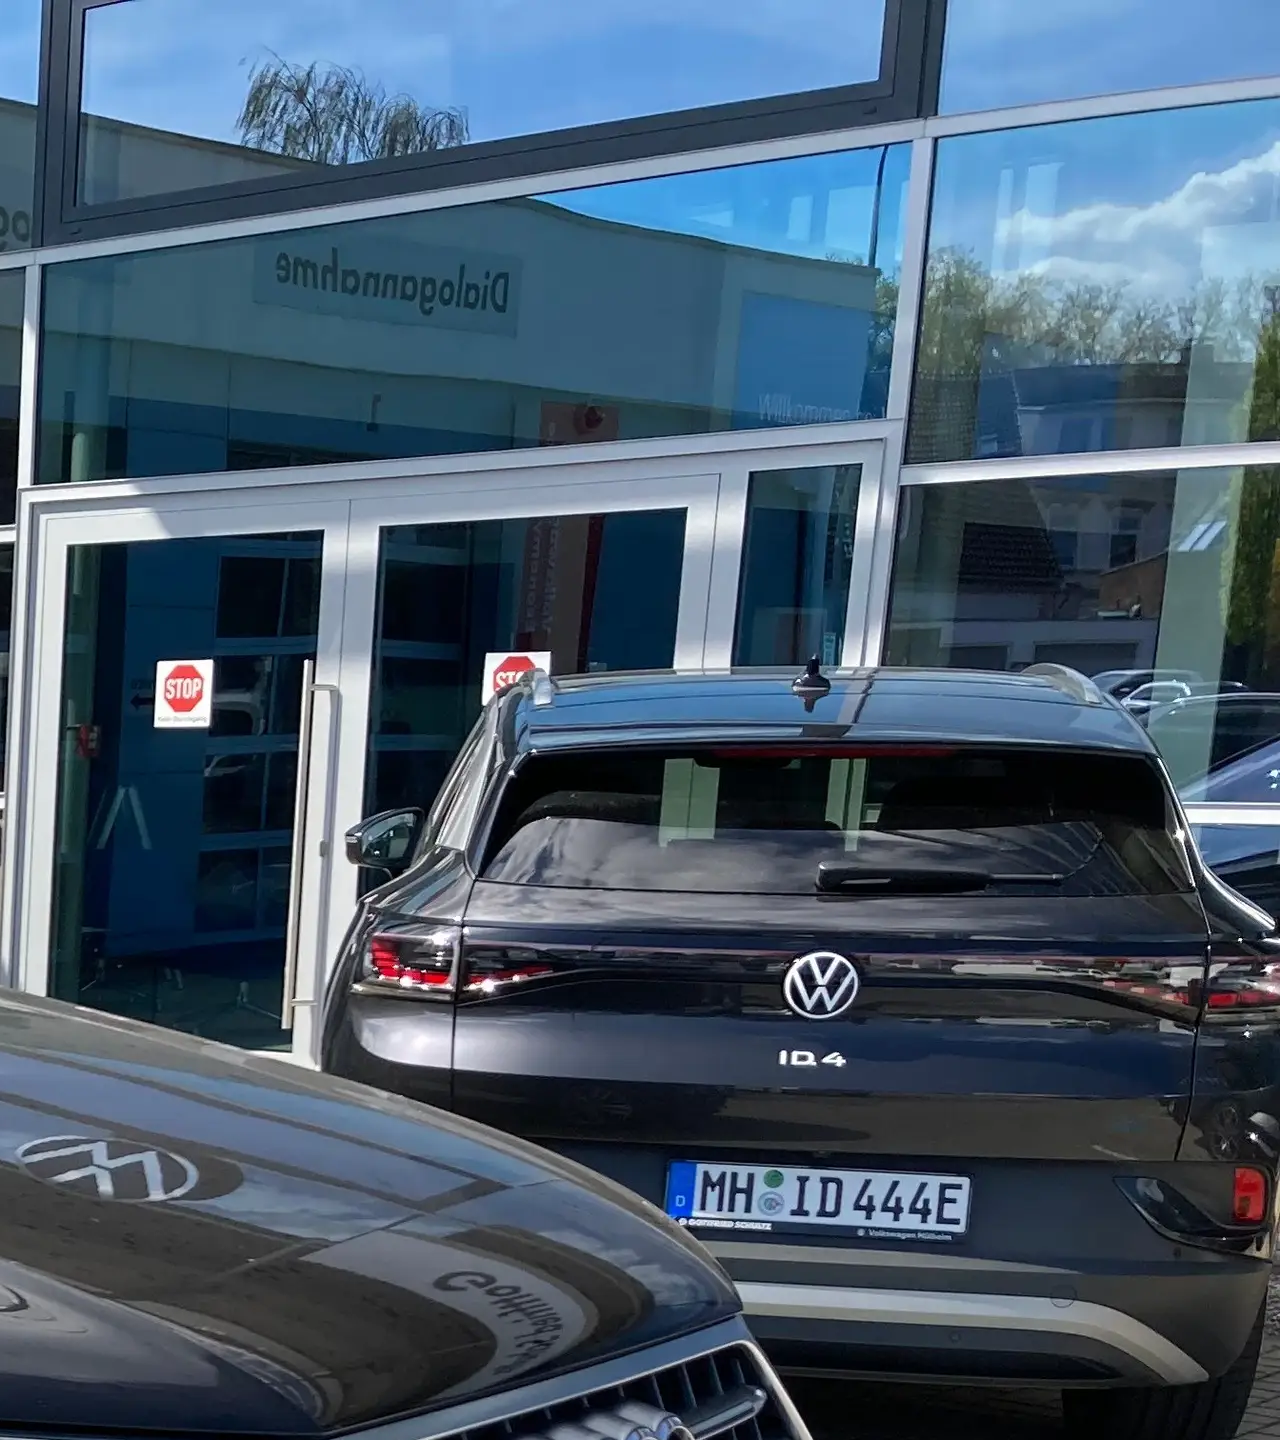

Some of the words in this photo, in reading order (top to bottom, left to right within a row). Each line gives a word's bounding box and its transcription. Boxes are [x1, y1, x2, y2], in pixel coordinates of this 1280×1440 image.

[165, 677, 203, 700] STOP
[495, 671, 526, 691] ST
[700, 1170, 755, 1214] MH
[790, 1175, 842, 1218] ID
[853, 1179, 963, 1225] 444E
